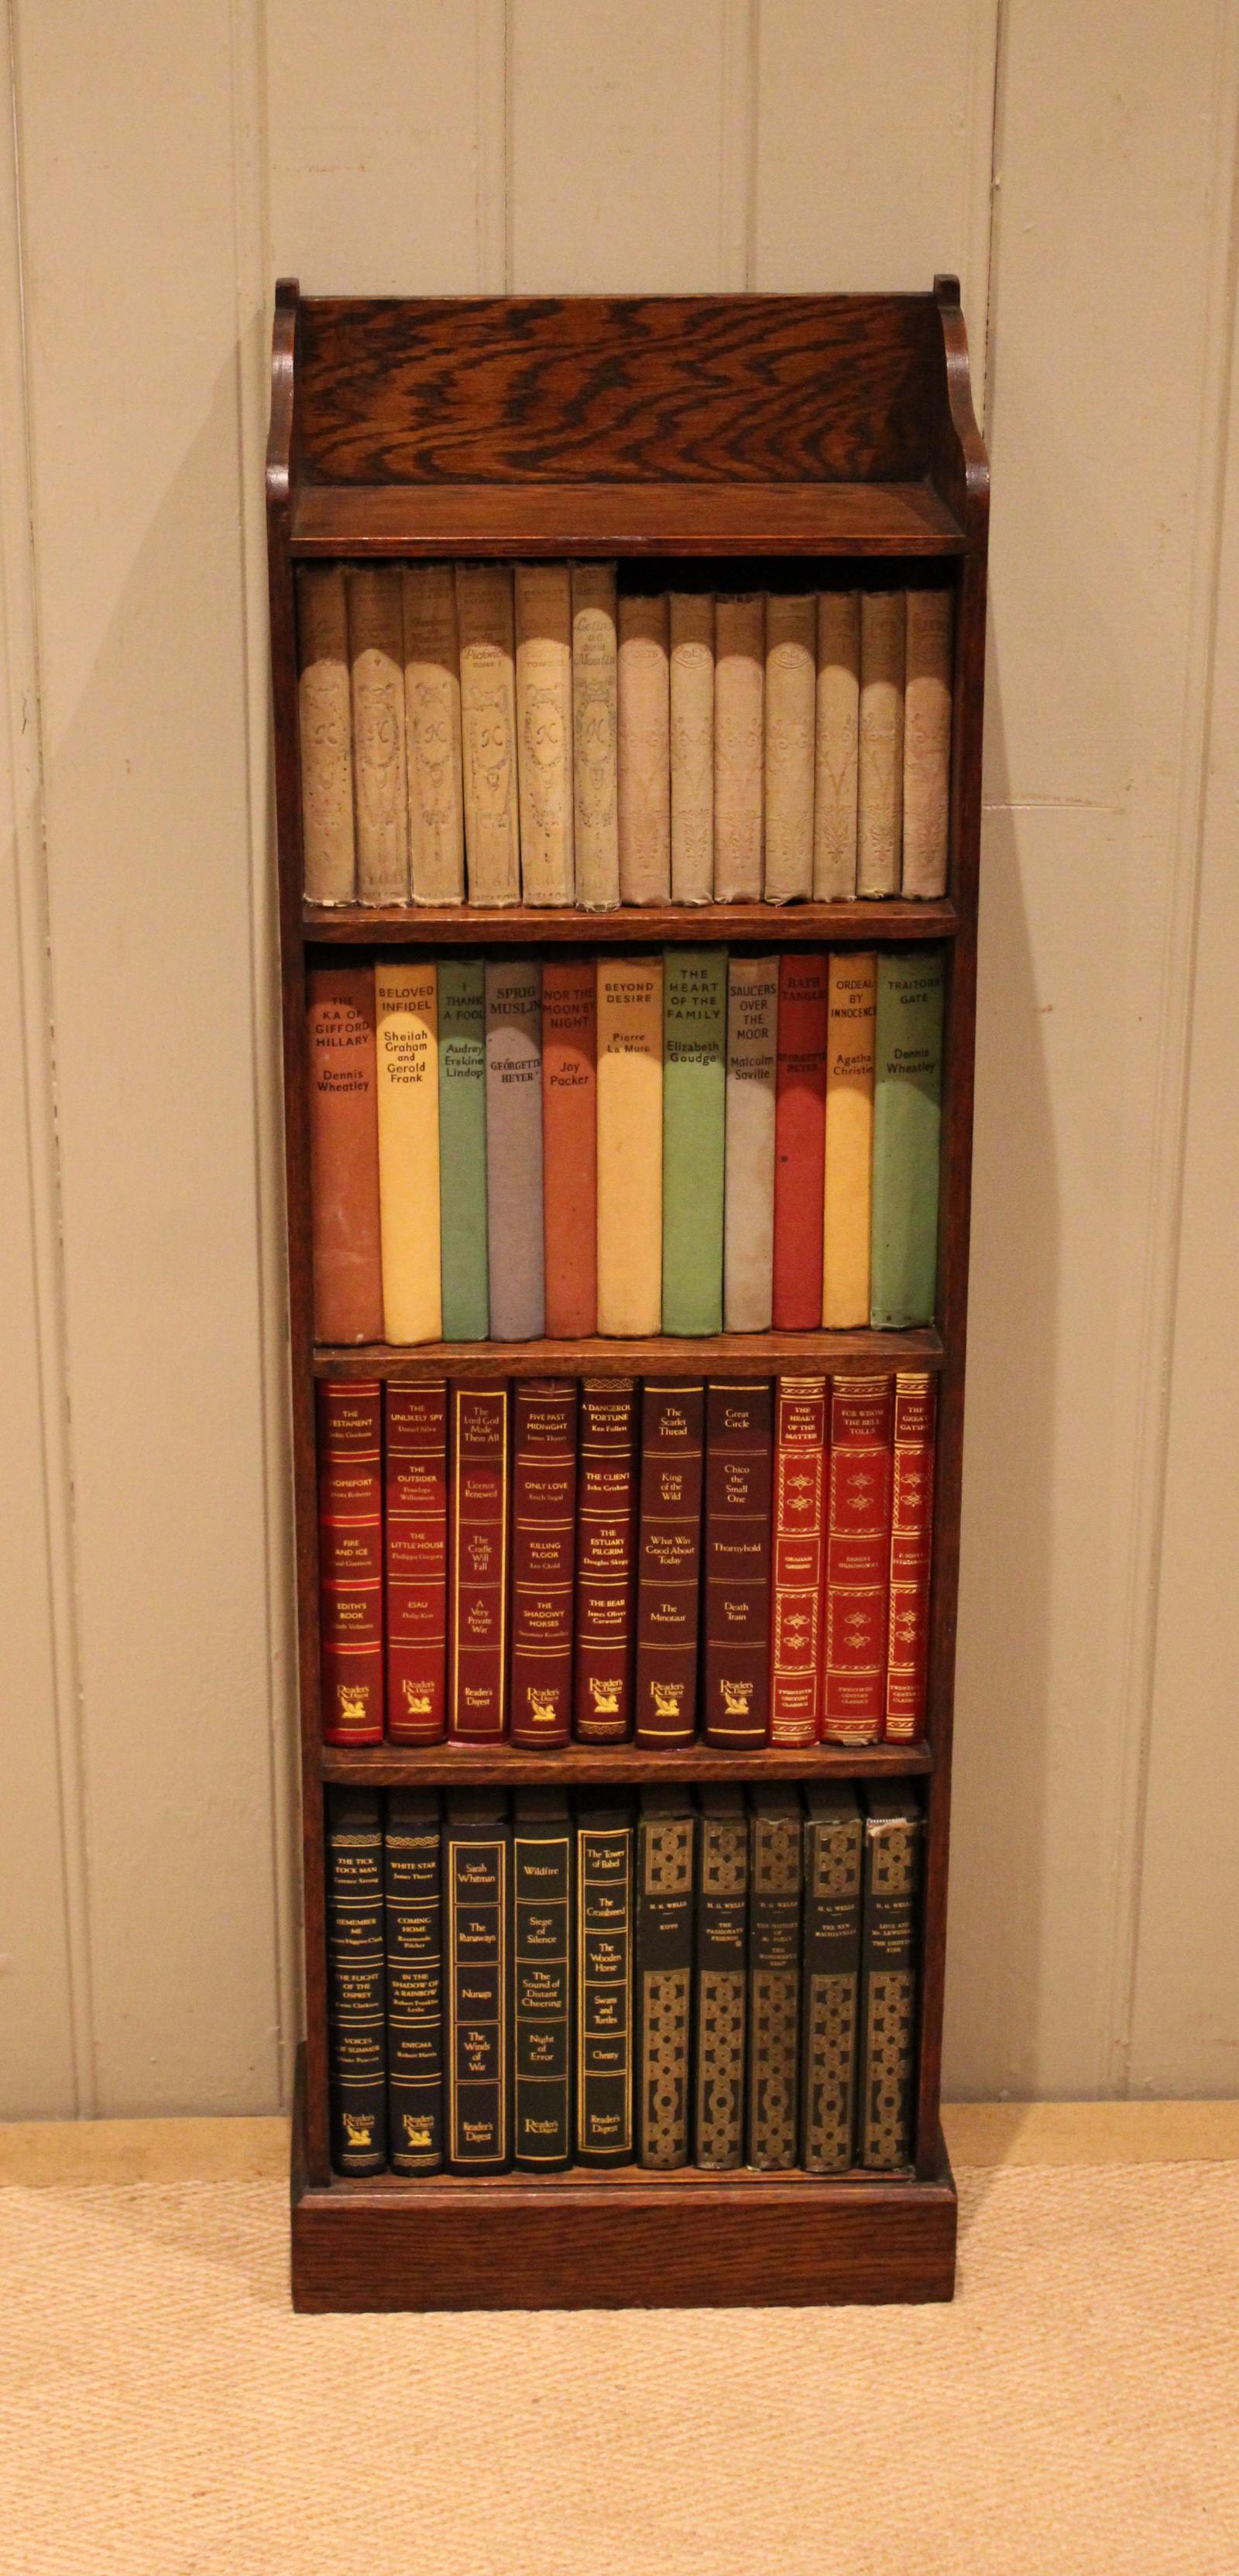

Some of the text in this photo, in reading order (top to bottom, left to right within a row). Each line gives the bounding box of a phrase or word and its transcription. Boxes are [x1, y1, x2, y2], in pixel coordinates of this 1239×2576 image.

[681, 970, 707, 979] THE
[606, 983, 653, 991] BEYOND
[670, 983, 719, 992] HEART
[836, 980, 873, 990] ORDEAL
[379, 986, 434, 997] BELOVED
[497, 986, 535, 999] SPRIG
[545, 989, 593, 1000] NOR THE
[731, 985, 776, 996] SAUCERS
[446, 996, 483, 1006] THANK
[693, 996, 716, 1005] THE
[849, 994, 863, 1003] BY
[901, 993, 928, 1004] GATE
[383, 1001, 431, 1011] INFIDEL
[490, 1000, 541, 1014] MUSLIN
[544, 1005, 579, 1014] MOON
[740, 1000, 767, 1010] OVER
[347, 1010, 362, 1019] OF
[444, 1010, 485, 1020] A FOOL
[668, 1010, 720, 1019] FAMILY
[551, 1017, 588, 1028] NIGHT
[743, 1015, 764, 1024] THE
[316, 1022, 369, 1034] GIFFORD
[384, 1031, 427, 1041] Sheilah
[737, 1029, 768, 1040] MOOR
[317, 1035, 368, 1046] HILLARY
[385, 1042, 427, 1051] Graham
[447, 1044, 483, 1056] Audrey
[668, 1041, 719, 1051] Elizabeth
[398, 1053, 415, 1062] and
[894, 1048, 929, 1059] Dennis
[445, 1056, 484, 1065] Erskine
[670, 1053, 716, 1065] Goudge
[731, 1056, 773, 1067] Malcolm
[837, 1053, 872, 1066] Agatha
[387, 1062, 425, 1073] Gerold
[560, 1062, 579, 1073] Joy
[833, 1065, 873, 1075] Christie
[887, 1062, 935, 1073] Wheatley
[324, 1070, 362, 1080] Dennis
[391, 1074, 422, 1082] Frank
[447, 1068, 482, 1079] Lindop
[502, 1073, 533, 1082] HEYER
[736, 1068, 769, 1080] Saville
[551, 1076, 589, 1086] Packer
[317, 1082, 369, 1092] Wheatley
[726, 1409, 749, 1418] Great
[725, 1419, 750, 1428] Circle
[725, 1465, 750, 1473] Chico
[662, 1473, 682, 1482] King
[731, 1475, 743, 1484] the
[726, 1484, 747, 1493] Small
[662, 1492, 681, 1501] Wild
[727, 1494, 746, 1503] One
[651, 1536, 673, 1545] What
[658, 1556, 681, 1564] Today
[661, 1604, 678, 1613] The
[725, 1602, 749, 1611] Death
[471, 1608, 489, 1617] Very
[726, 1612, 746, 1621] Train
[587, 1849, 602, 1857] The
[524, 1866, 559, 1875] Wildfire
[458, 1874, 496, 1883] Whitman
[599, 1898, 613, 1906] The
[530, 1917, 552, 1926] Siege
[470, 1923, 486, 1931] The
[459, 1933, 496, 1943] Runaways
[599, 1943, 614, 1952] The
[590, 1953, 621, 1962] Wooden
[595, 1963, 616, 1971] Horse
[522, 1998, 561, 2008] Cheering
[468, 2032, 485, 2041] The
[530, 2036, 554, 2044] Night
[472, 2052, 481, 2061] of
[468, 2063, 486, 2071] War
